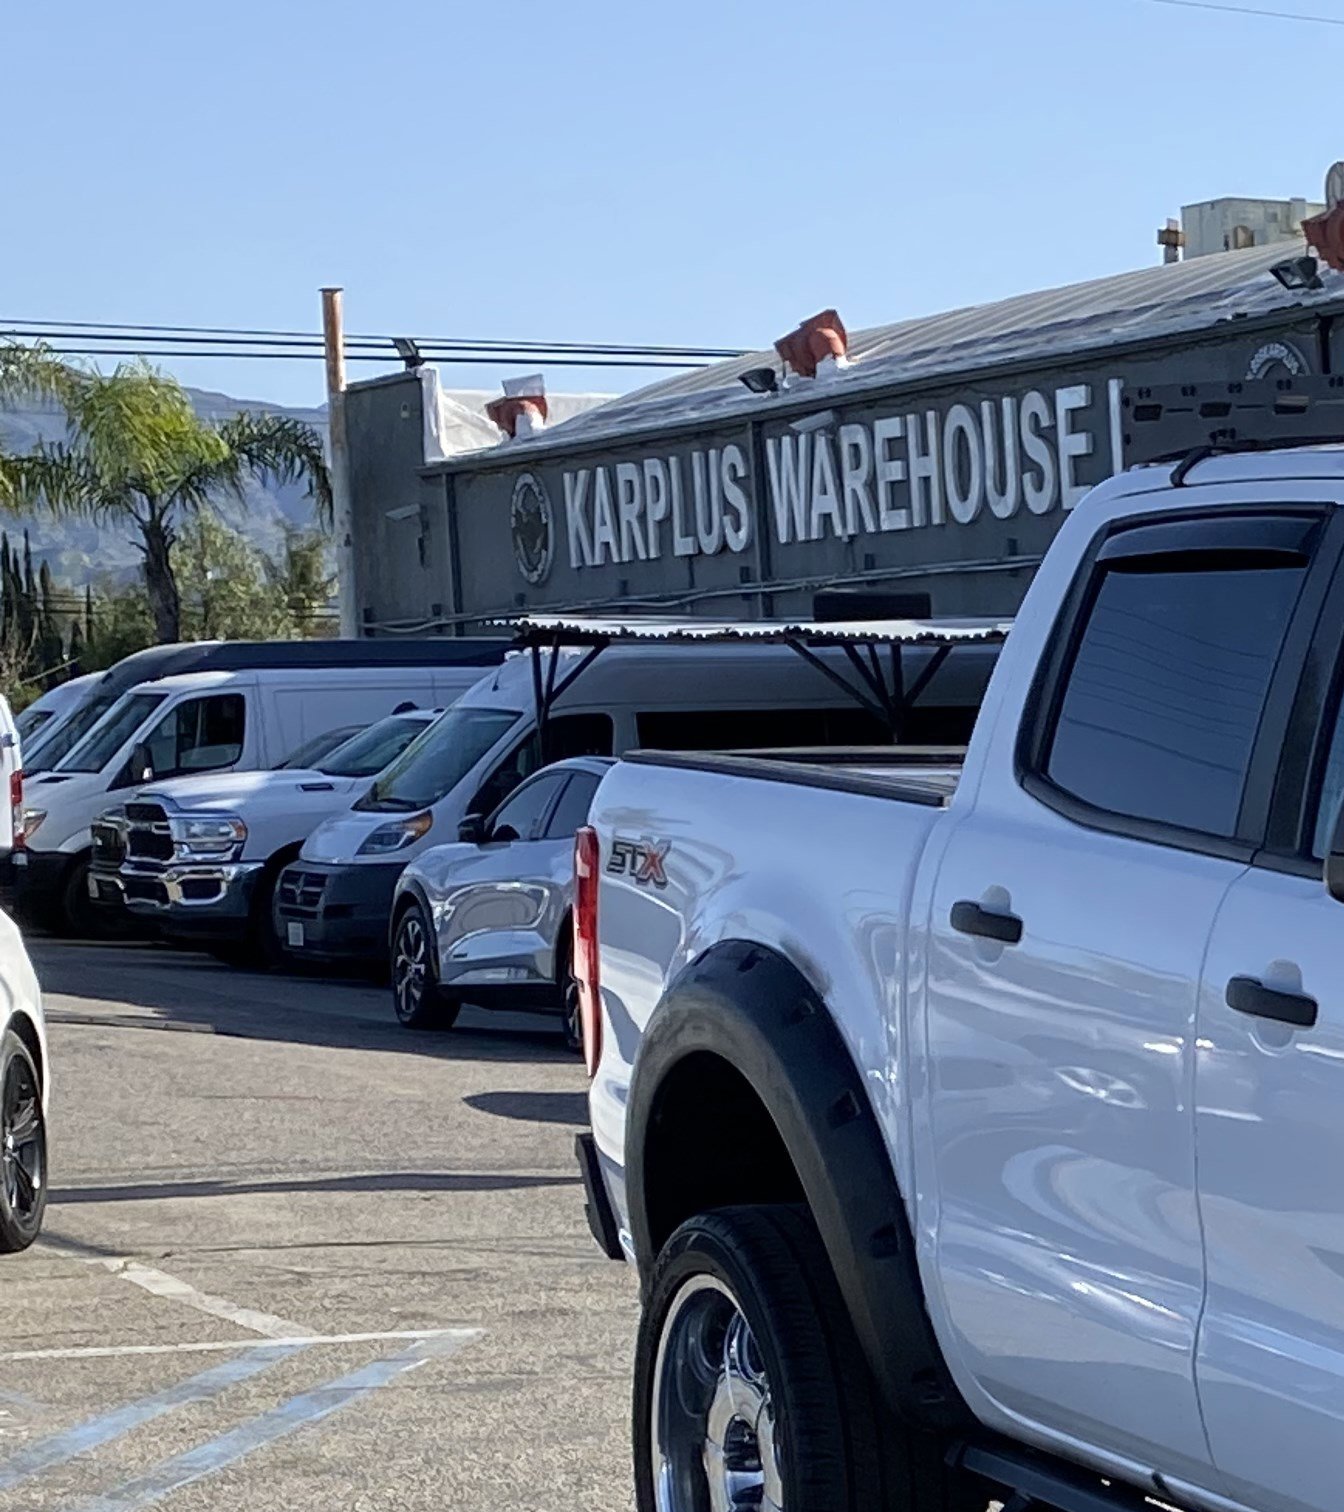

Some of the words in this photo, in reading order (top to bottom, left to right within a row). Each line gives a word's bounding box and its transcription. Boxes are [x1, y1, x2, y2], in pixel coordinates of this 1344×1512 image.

[563, 445, 750, 569] KARPLUS
[766, 384, 1094, 544] WAREHOUSE
[606, 834, 672, 890] STX
